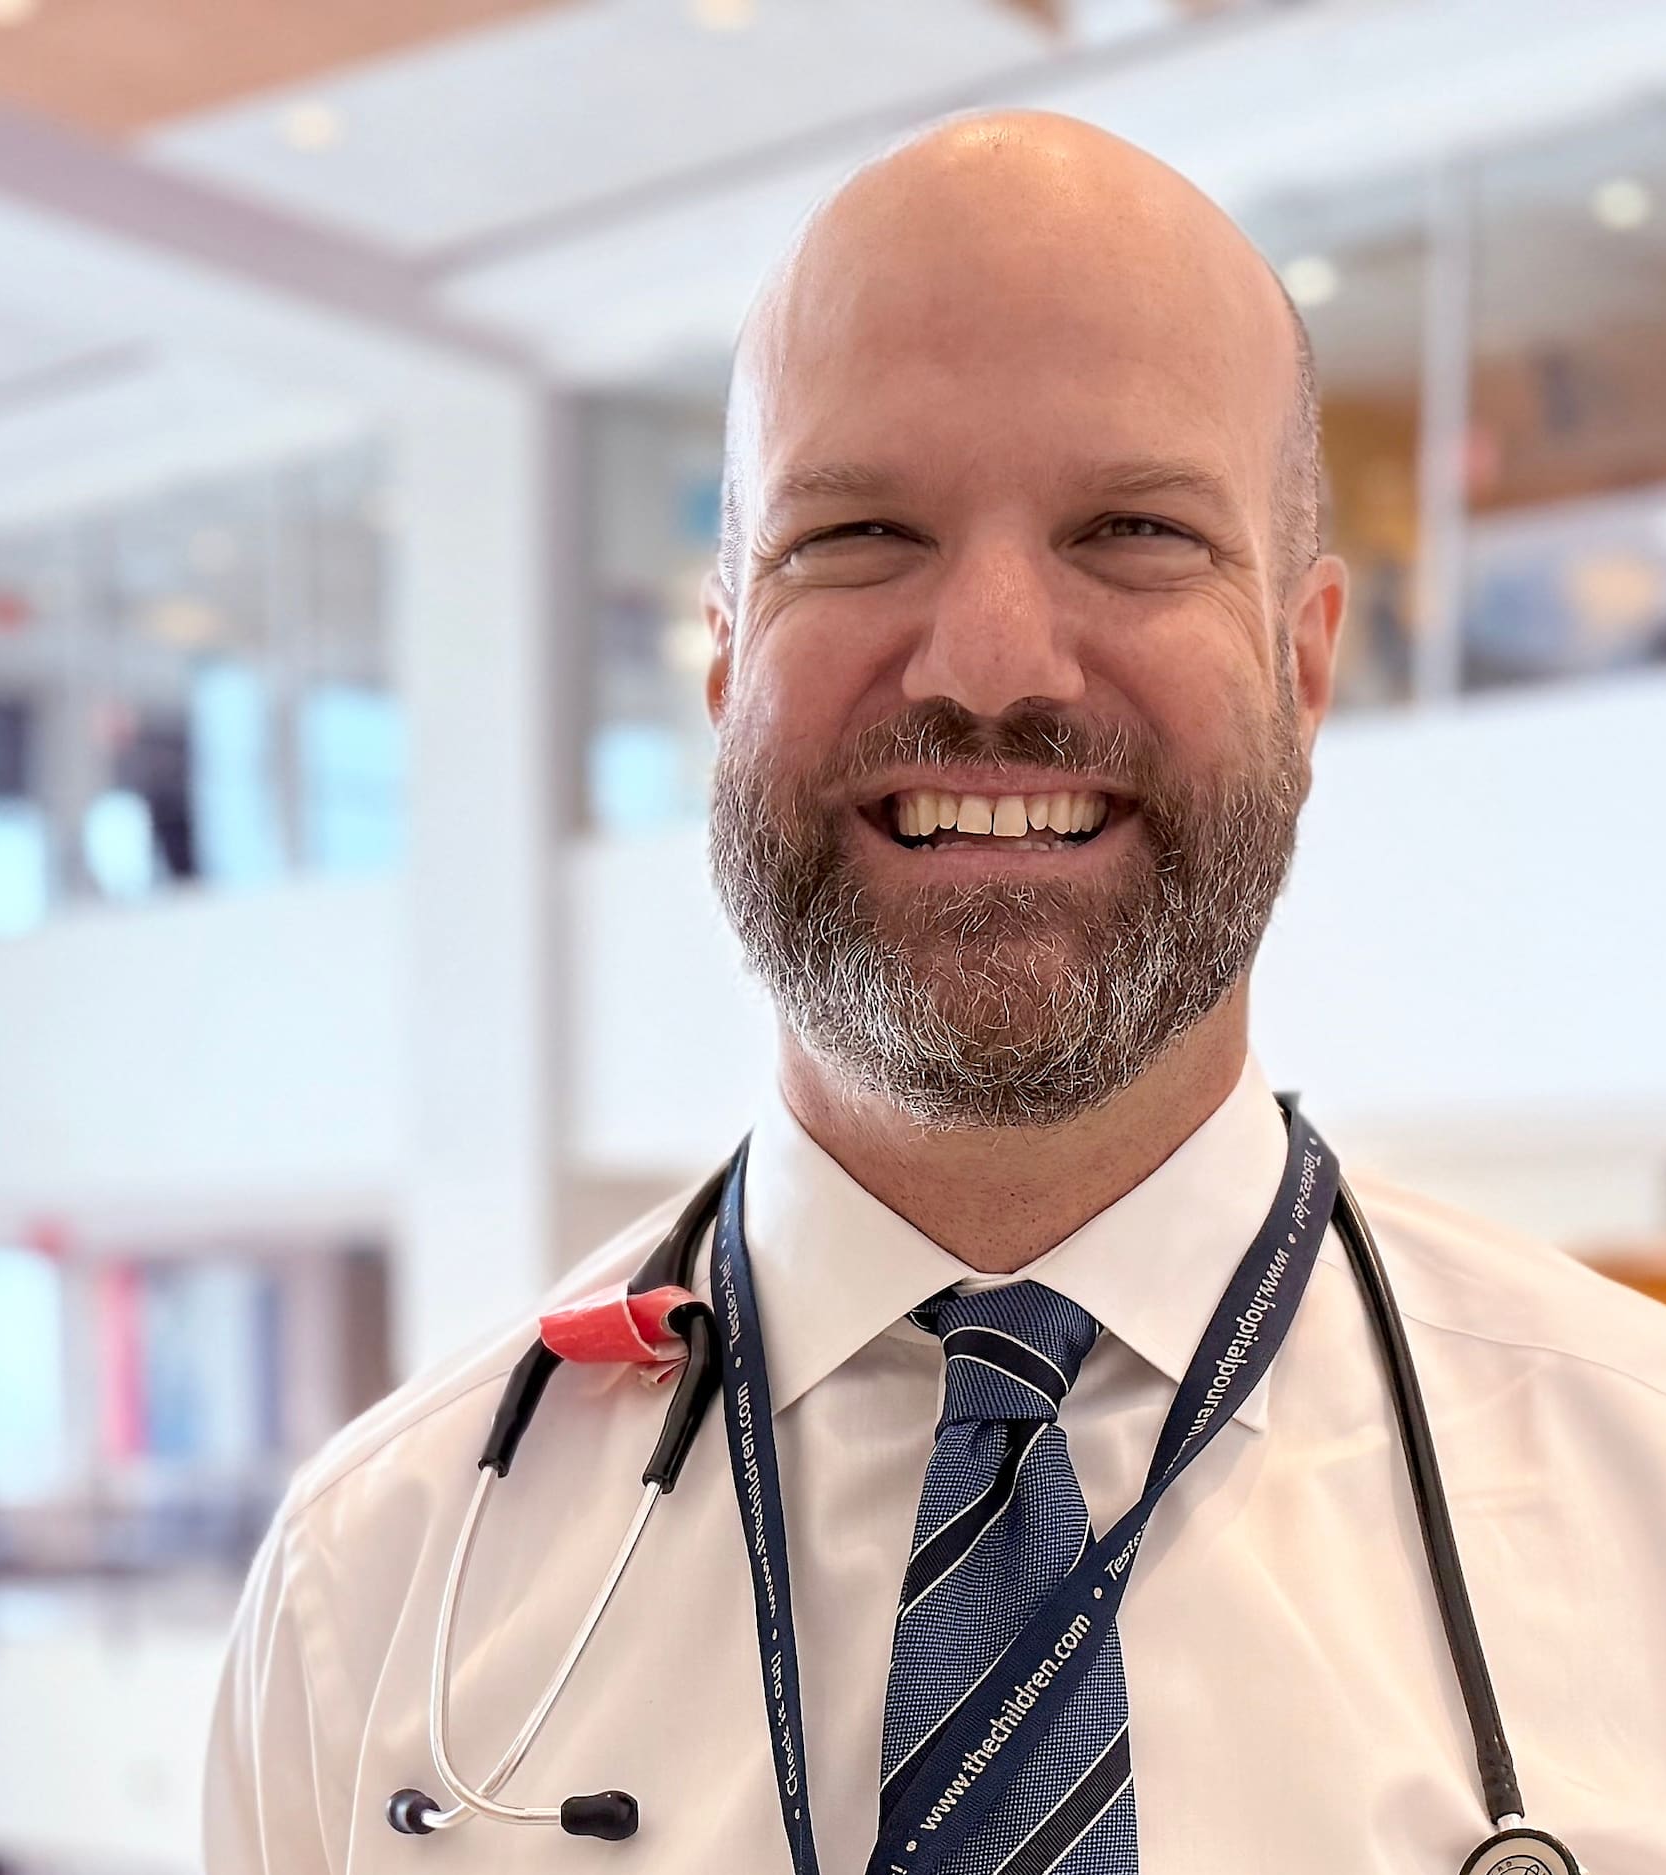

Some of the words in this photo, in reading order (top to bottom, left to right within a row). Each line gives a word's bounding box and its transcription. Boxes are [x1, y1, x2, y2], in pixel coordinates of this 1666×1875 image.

[1292, 1150, 1321, 1229] Testez-le!
[737, 1382, 776, 1618] www.thechildren.com
[782, 1726, 798, 1797] Check
[920, 1613, 1091, 1831] www.thechildren.com
